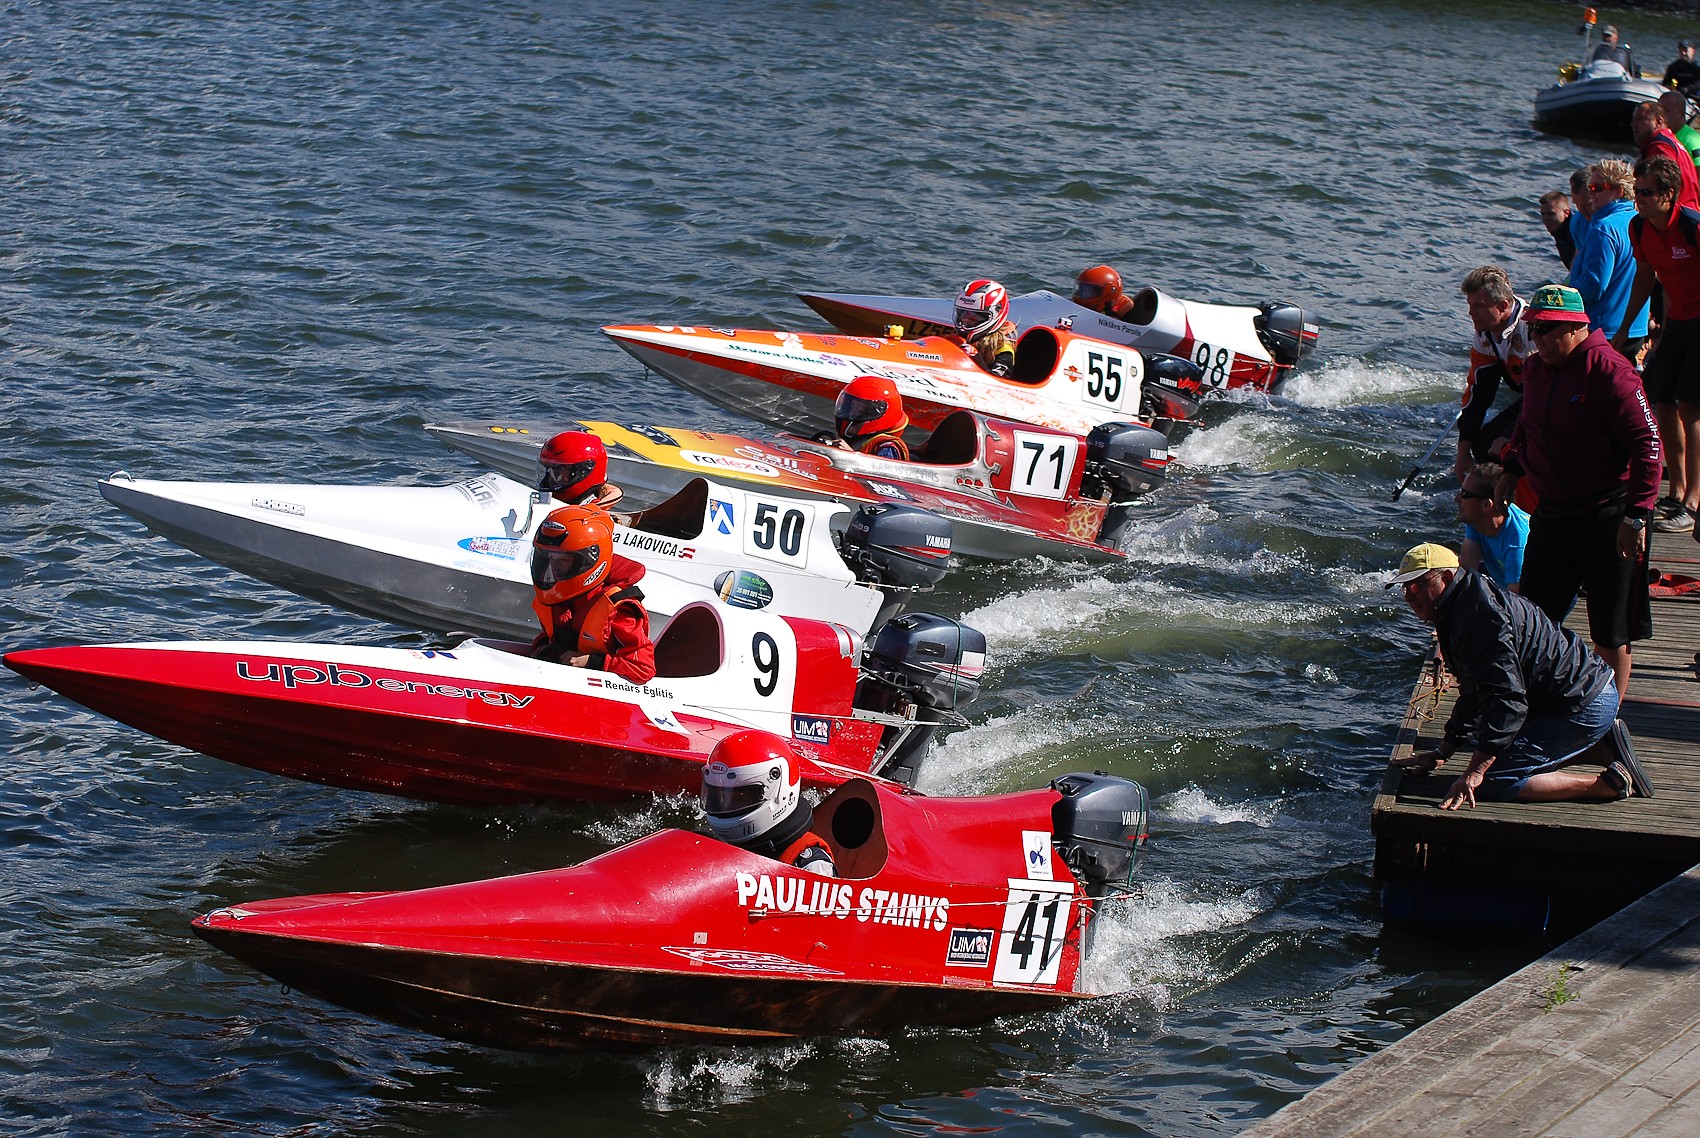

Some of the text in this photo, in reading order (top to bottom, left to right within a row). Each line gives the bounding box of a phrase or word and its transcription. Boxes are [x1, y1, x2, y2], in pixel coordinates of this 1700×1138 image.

[909, 352, 940, 361] YAMAHA
[1087, 352, 1122, 402] 55
[1196, 342, 1229, 386] 98
[1636, 389, 1660, 460] LITHUANIA
[1022, 441, 1066, 490] 71
[623, 532, 678, 558] LAKOVICA
[753, 502, 805, 557] 50
[925, 534, 952, 549] YAMAHA
[752, 631, 780, 697] 9
[793, 719, 816, 736] UIM
[1121, 810, 1147, 826] YAMAA
[736, 872, 950, 932] PAULIUS STAINYS
[951, 935, 976, 953] UIM
[1010, 893, 1062, 971] 41
